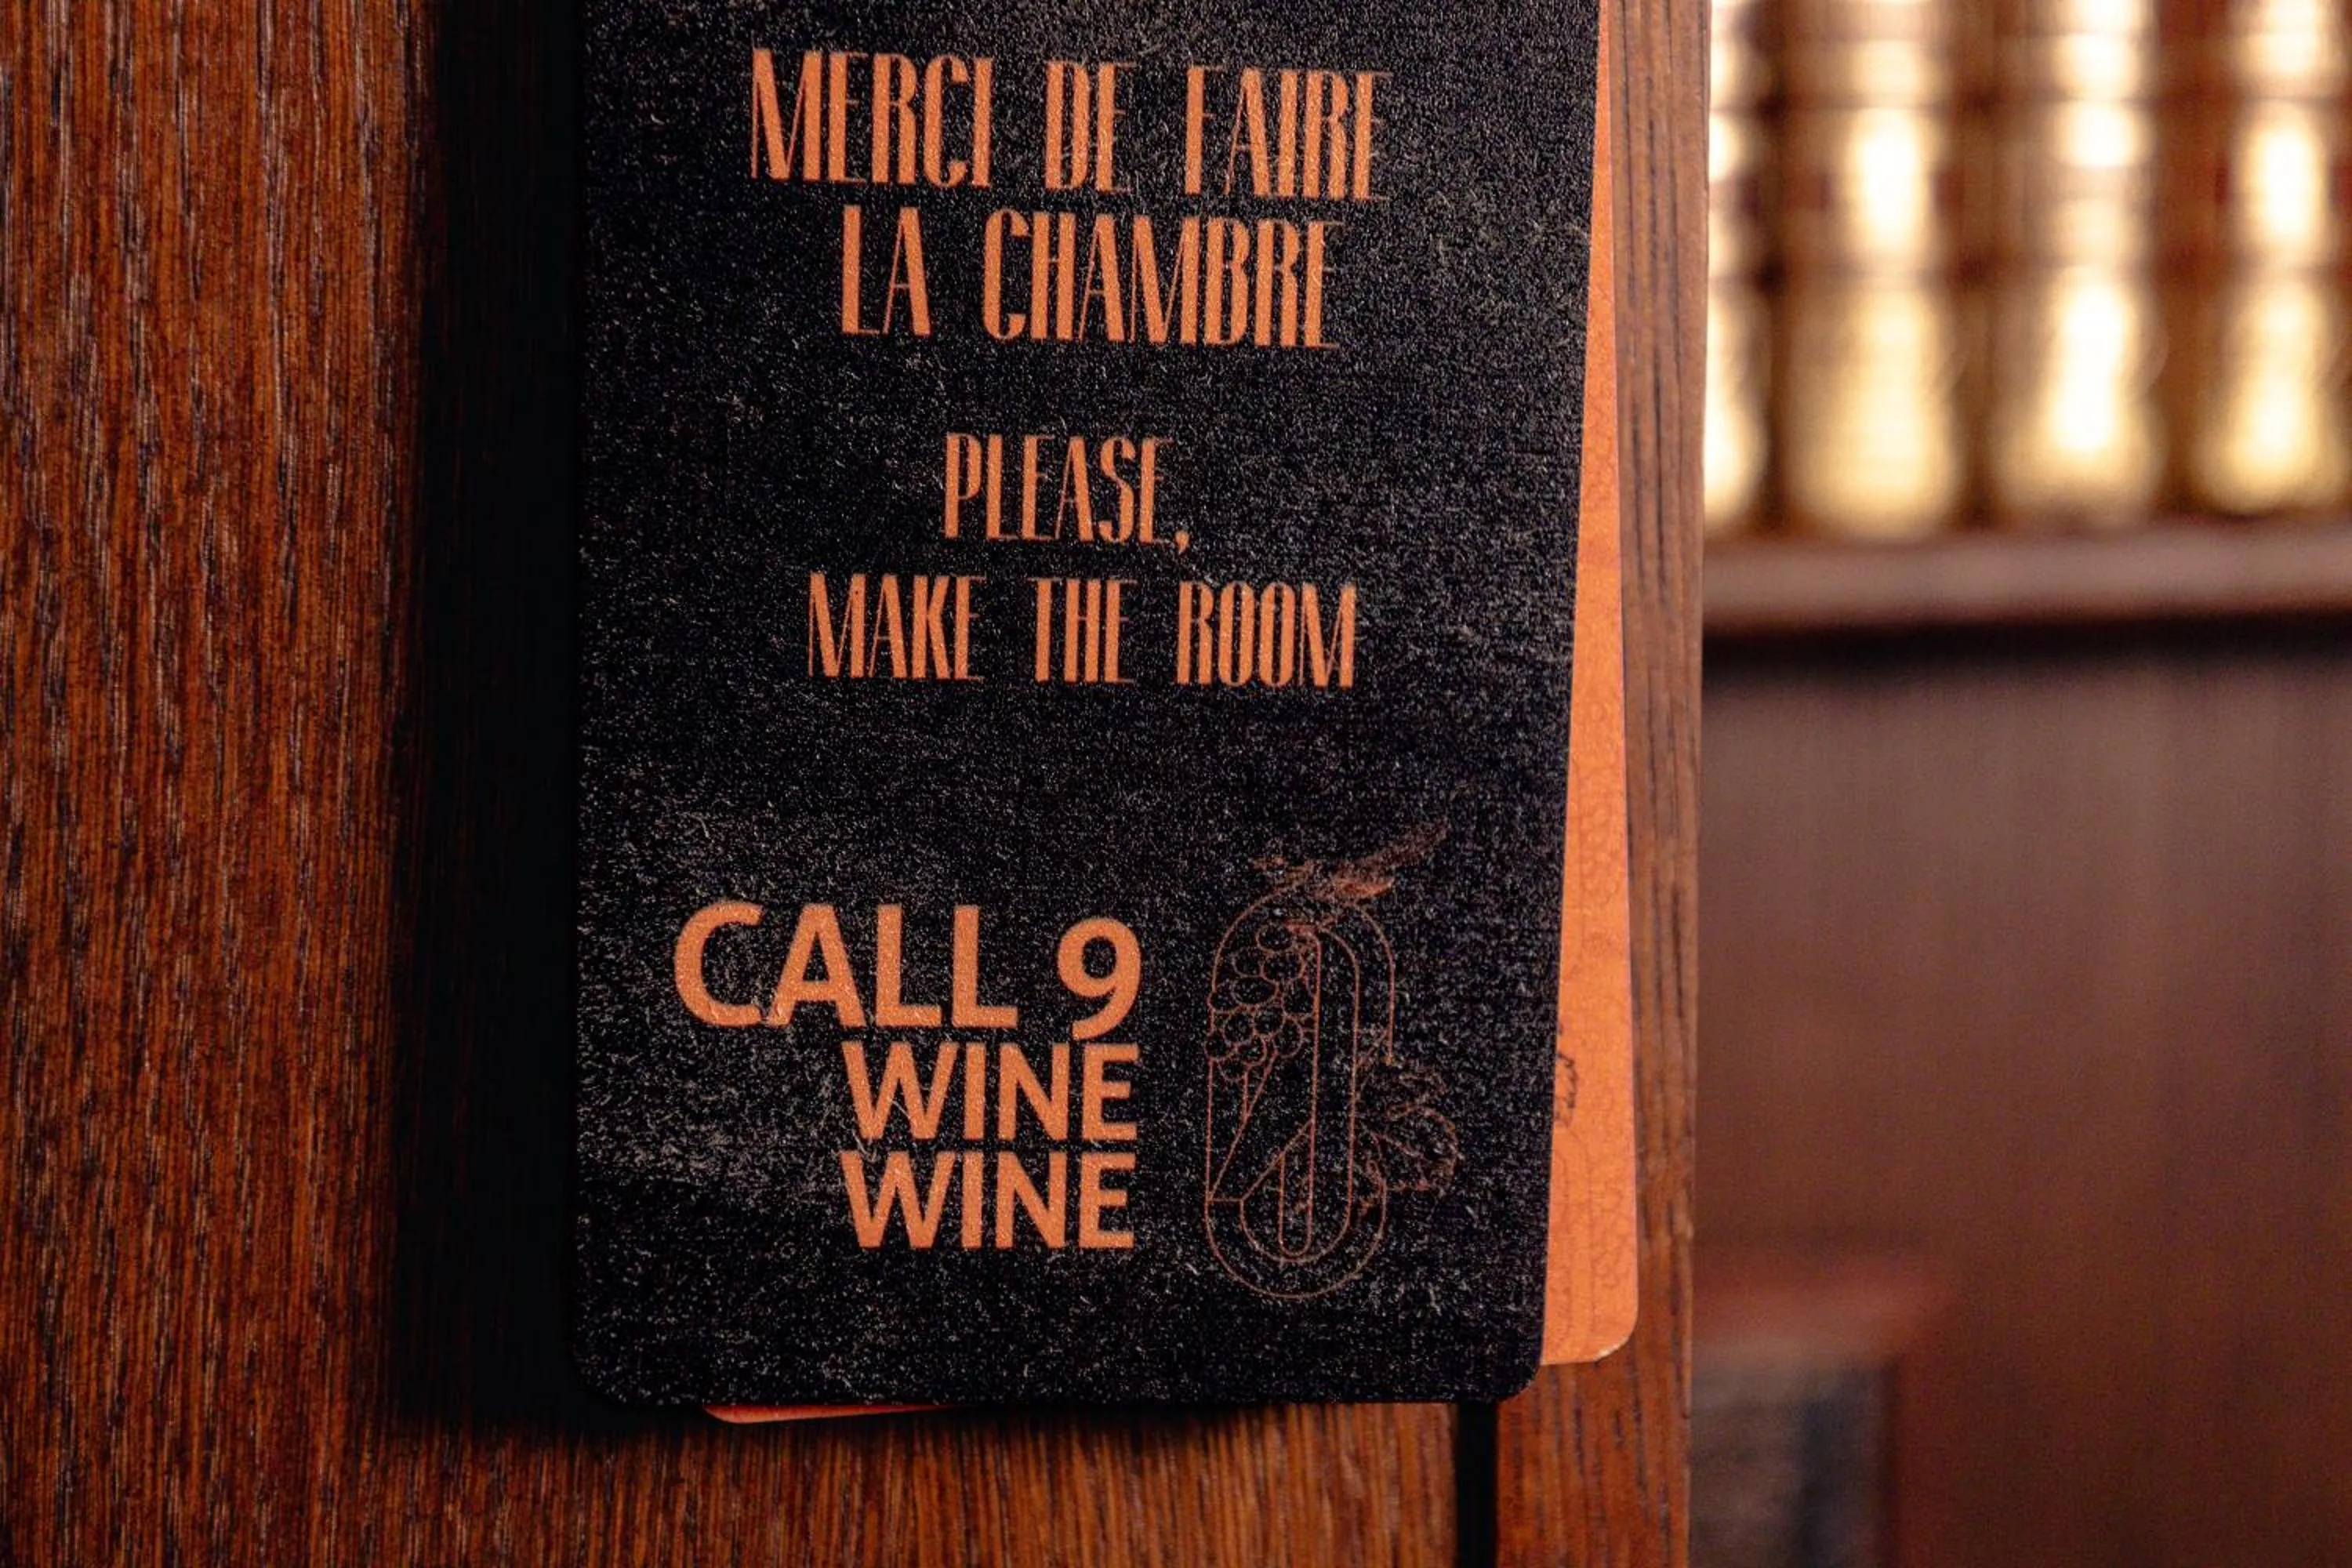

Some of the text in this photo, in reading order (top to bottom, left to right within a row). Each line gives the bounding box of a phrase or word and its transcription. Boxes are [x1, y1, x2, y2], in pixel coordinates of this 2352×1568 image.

[750, 48, 1389, 201] MERCI DE FAIRE
[840, 205, 1343, 349] LA CHAMBRE
[943, 432, 1191, 556] PLEASE,
[808, 572, 1356, 688] MAKE THE ROOM
[673, 901, 1142, 1042] CALL 9
[840, 1039, 1140, 1143] WINE
[839, 1149, 1137, 1250] WINE
